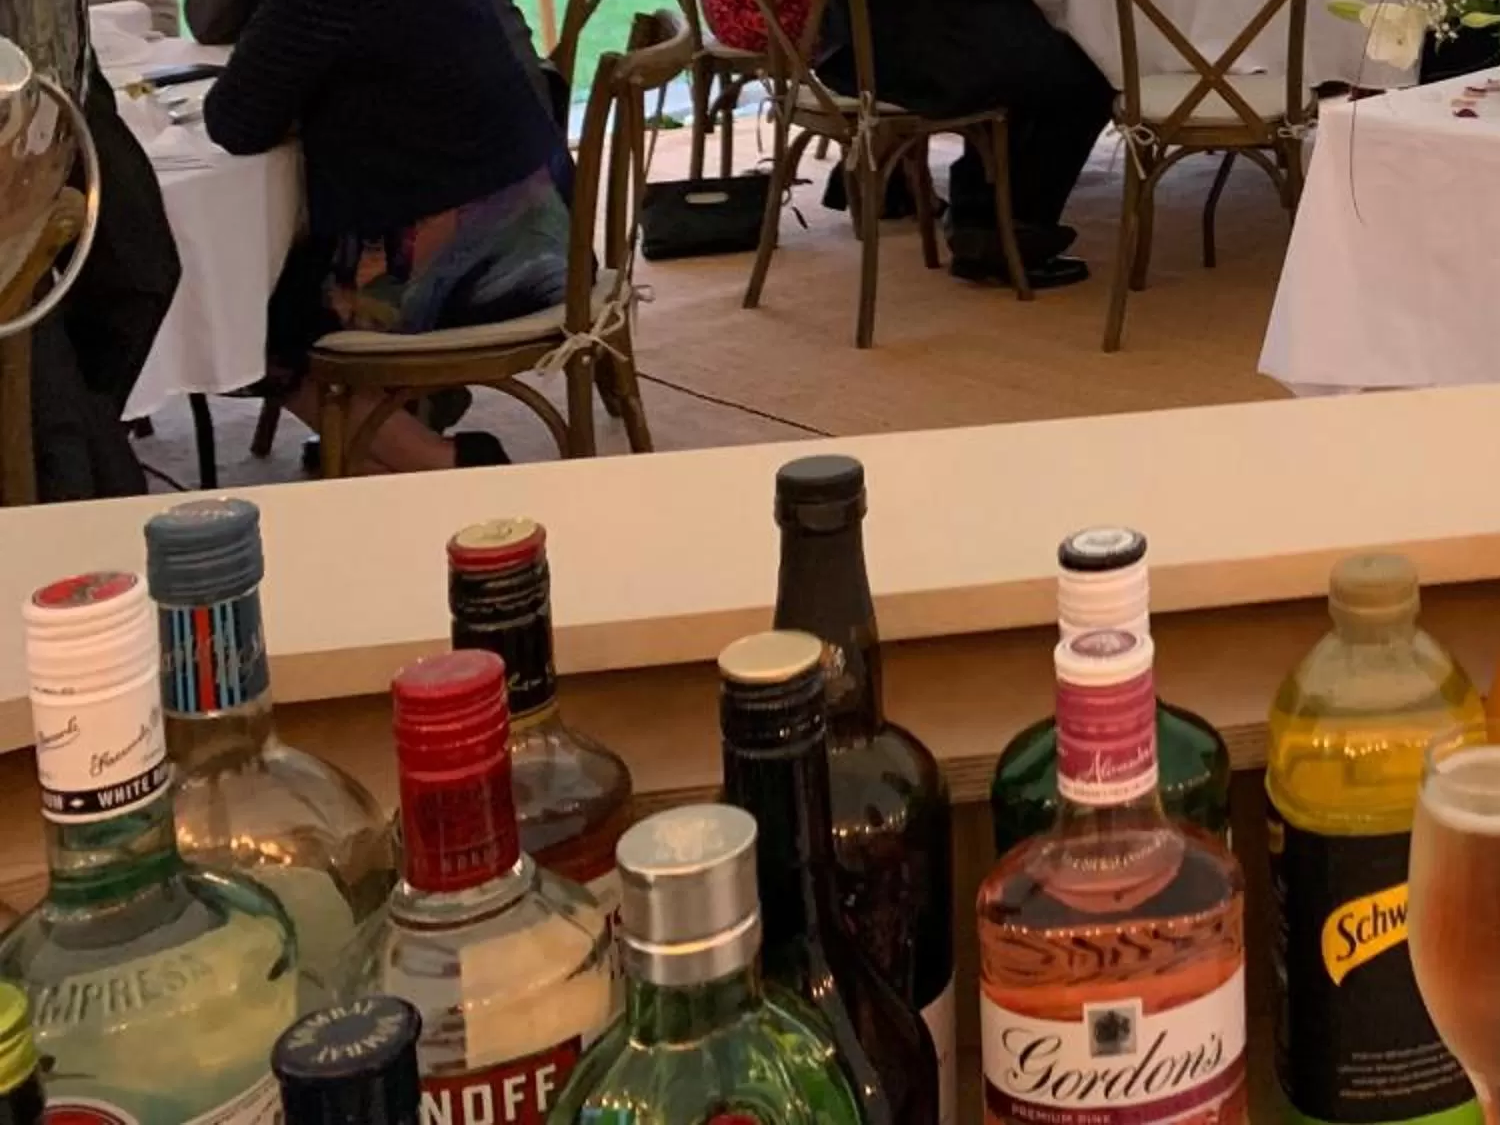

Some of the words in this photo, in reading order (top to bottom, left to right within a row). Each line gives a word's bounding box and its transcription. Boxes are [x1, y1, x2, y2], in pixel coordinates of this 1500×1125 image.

[97, 776, 151, 809] WHITE
[1335, 899, 1409, 963] Schw
[418, 1062, 558, 1125] NOFF
[1001, 1027, 1223, 1101] Gordon's
[1011, 1102, 1075, 1125] PREMIUM
